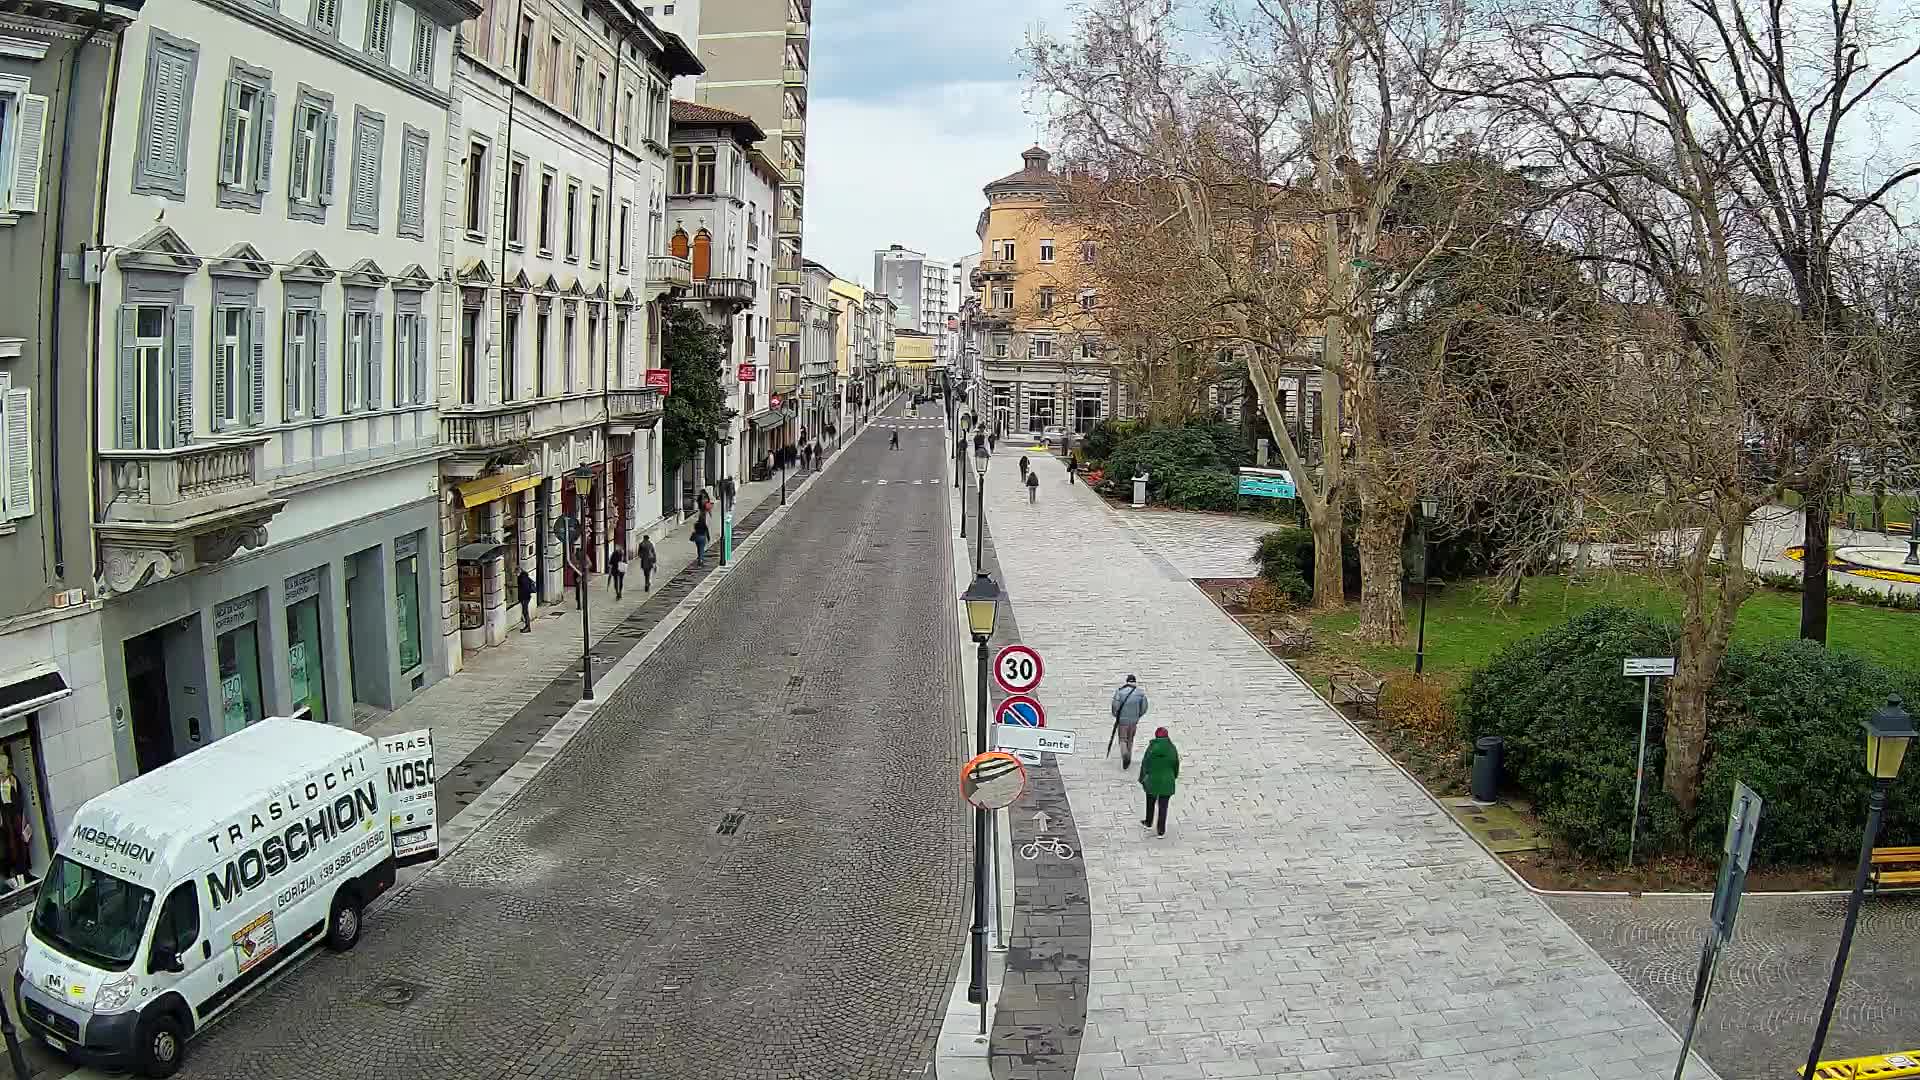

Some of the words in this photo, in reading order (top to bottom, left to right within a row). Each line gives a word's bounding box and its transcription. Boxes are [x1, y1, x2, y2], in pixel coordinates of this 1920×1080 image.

[1005, 658, 1033, 681] 30
[1038, 737, 1070, 749] Dante
[207, 757, 366, 853] TRASLOCHI
[73, 824, 155, 864] MOSCHION
[207, 780, 380, 912] MOSCHION
[71, 847, 143, 880] TRASLOCHI
[277, 875, 316, 907] GORIZIA
